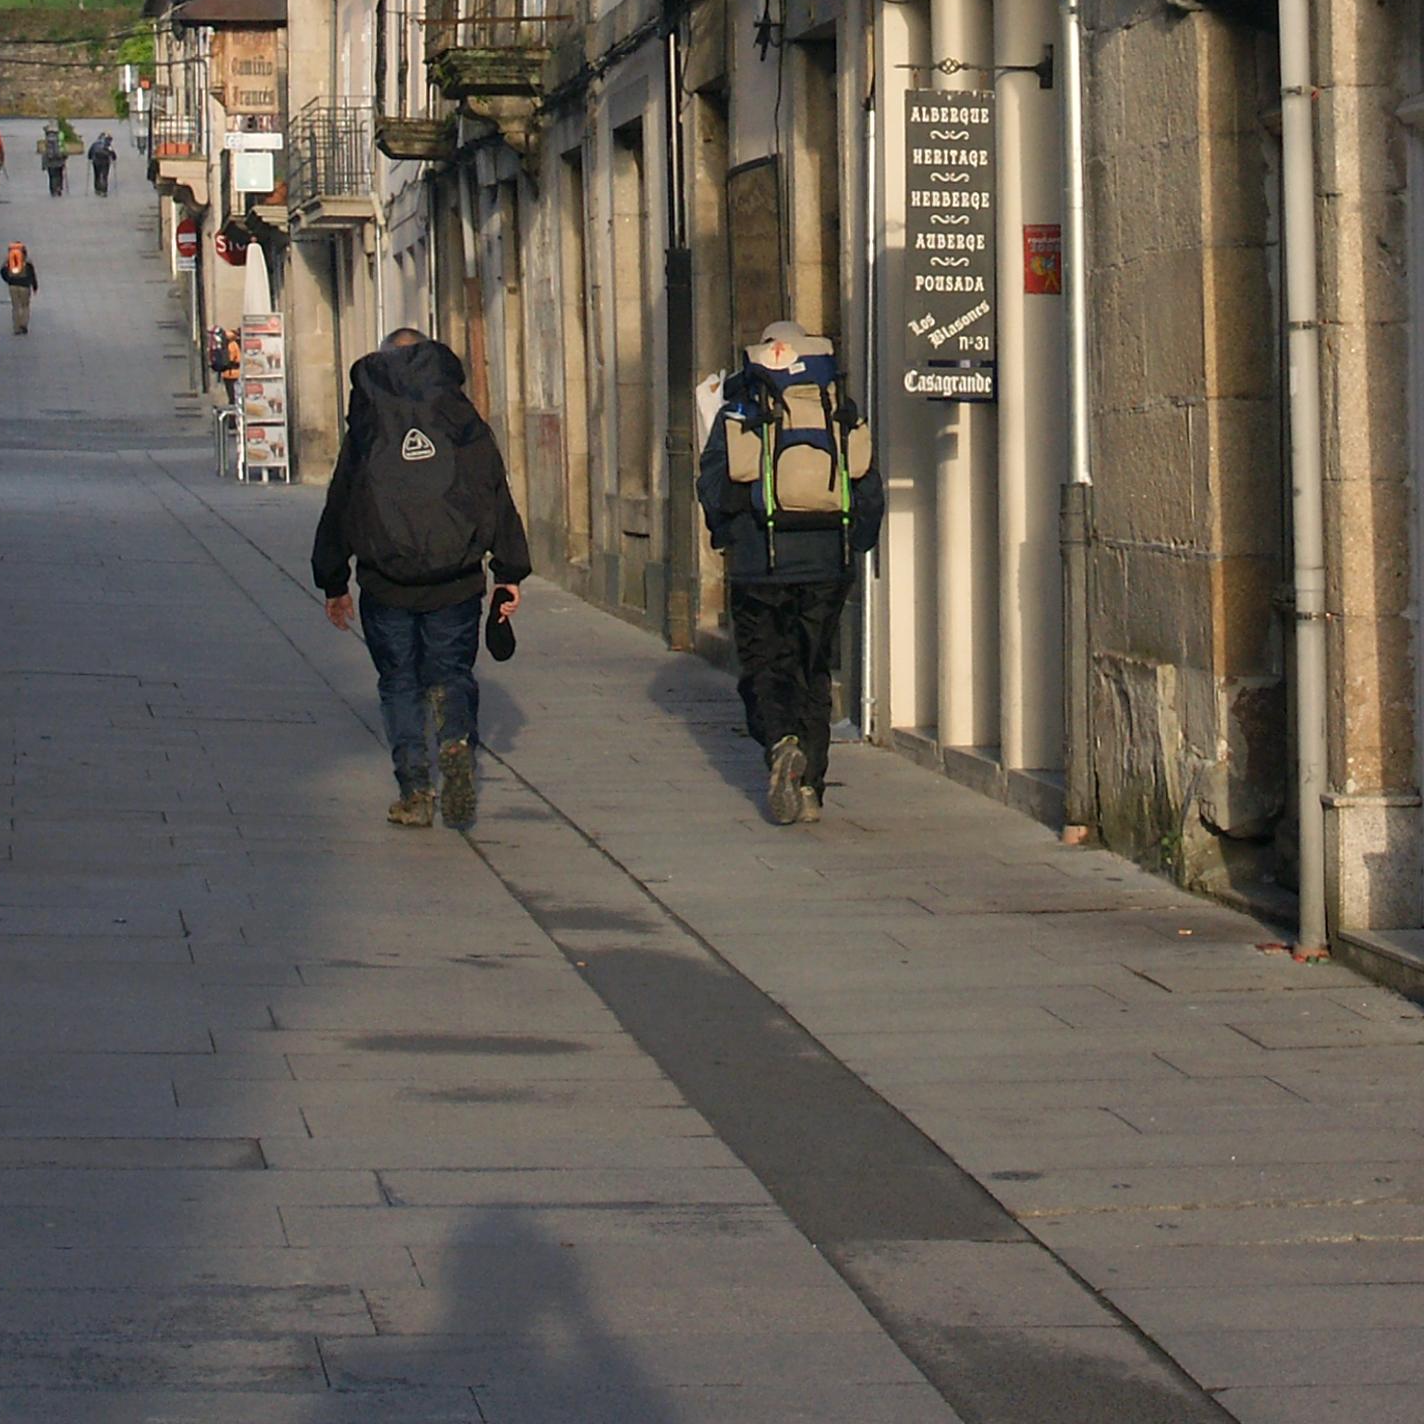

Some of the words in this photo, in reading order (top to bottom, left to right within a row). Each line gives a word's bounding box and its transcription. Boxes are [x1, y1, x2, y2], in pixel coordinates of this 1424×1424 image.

[911, 107, 989, 125] ALBERGUE
[913, 149, 988, 167] HERITAGE
[911, 191, 989, 210] HERBERGE
[915, 233, 985, 252] AUBERGE
[915, 275, 985, 292] POUSADA
[908, 312, 936, 336] Los
[927, 299, 990, 350] Blasones
[904, 369, 992, 396] Casagrande
